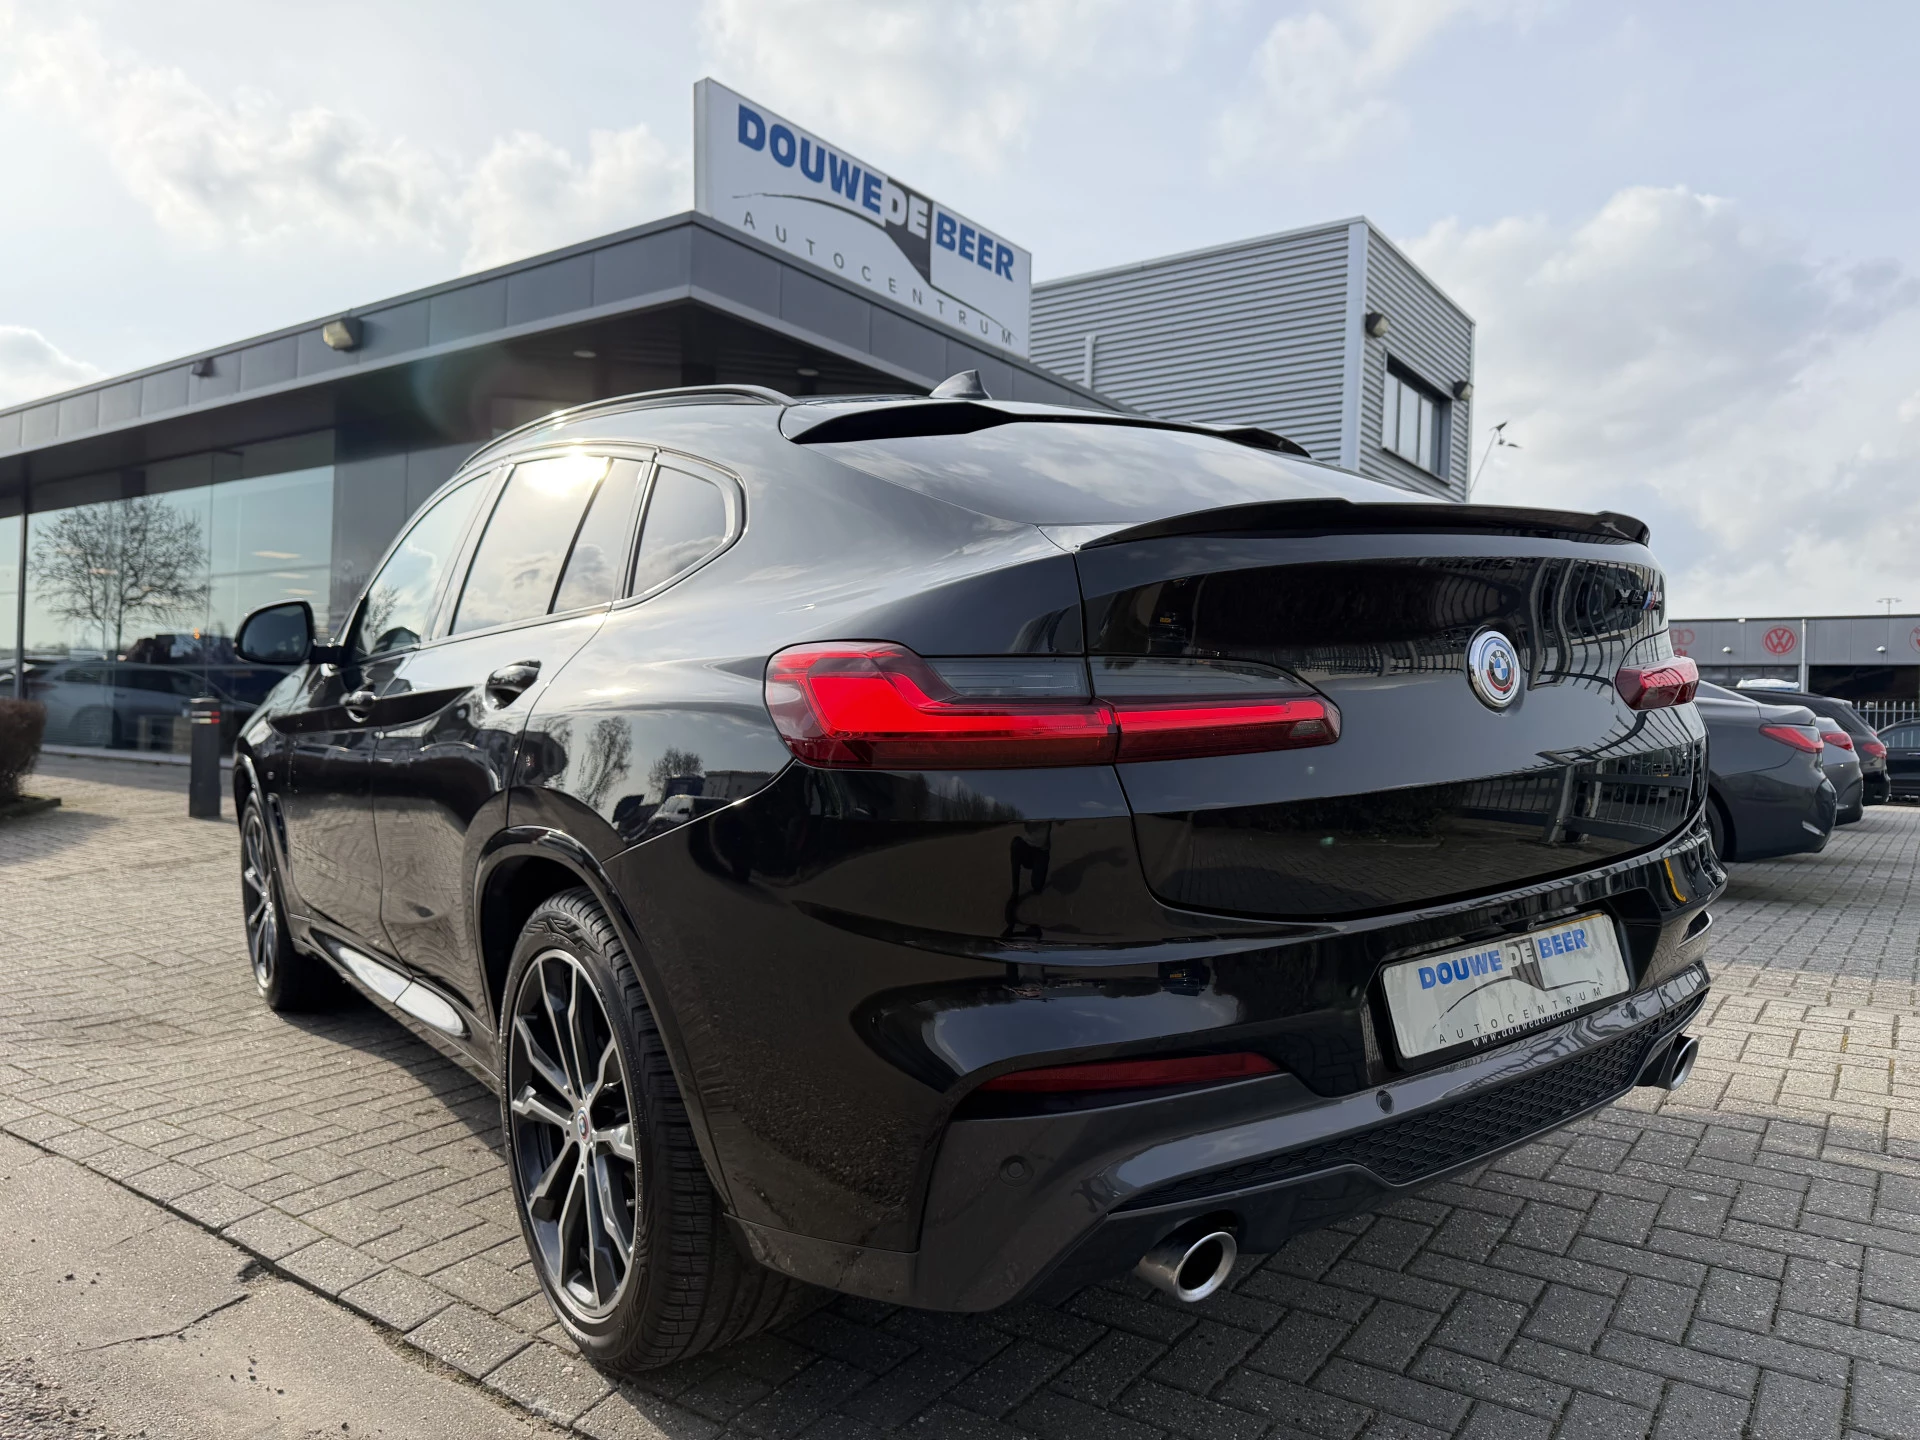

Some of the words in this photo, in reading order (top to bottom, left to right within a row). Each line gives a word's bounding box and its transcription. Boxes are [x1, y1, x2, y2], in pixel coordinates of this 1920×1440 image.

[738, 104, 881, 215] DOUWE
[884, 178, 928, 239] DE
[936, 211, 1014, 282] BEER
[743, 211, 1012, 346] AUTOCENTRUM
[1418, 950, 1503, 990] DOUWE
[1508, 942, 1534, 968] DE
[1538, 929, 1588, 959] BEER
[1439, 987, 1602, 1044] AUTOCENTRUM
